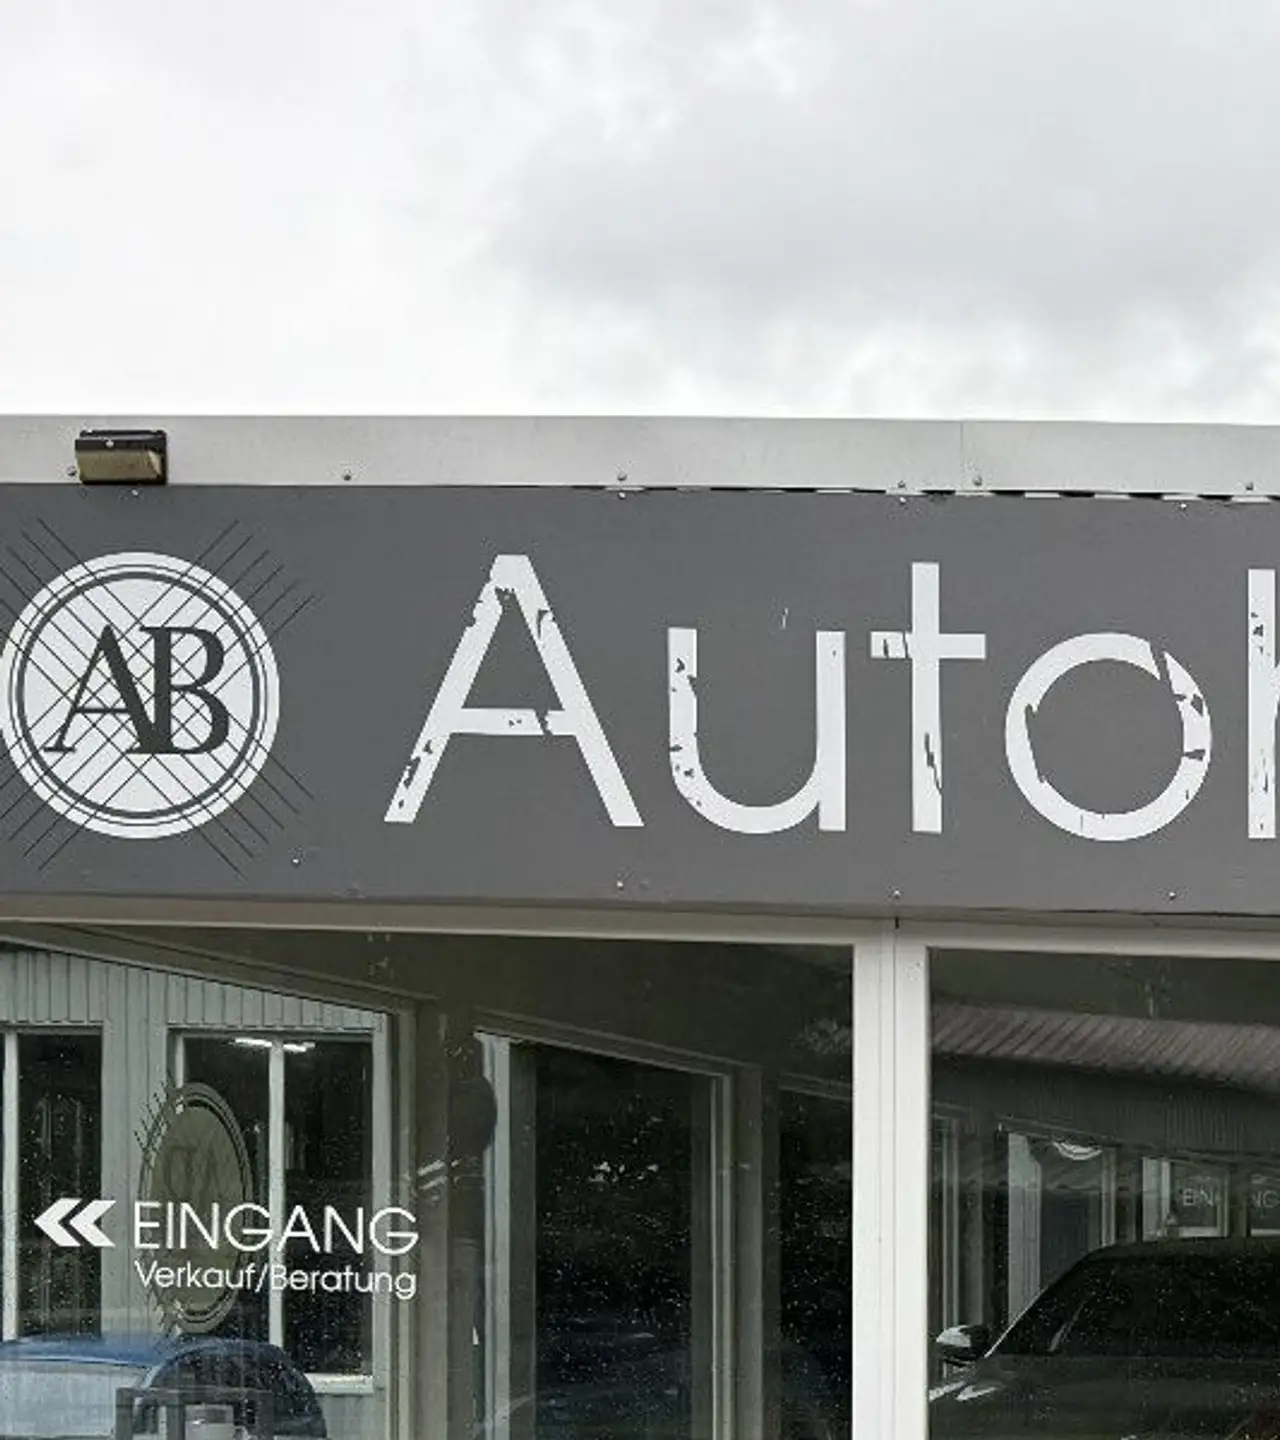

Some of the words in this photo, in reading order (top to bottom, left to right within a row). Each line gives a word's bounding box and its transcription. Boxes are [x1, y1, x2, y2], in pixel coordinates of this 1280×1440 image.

[43, 624, 230, 755] AB
[133, 1201, 419, 1256] EINGANG
[134, 1259, 418, 1300] Verkauf/Beratung
